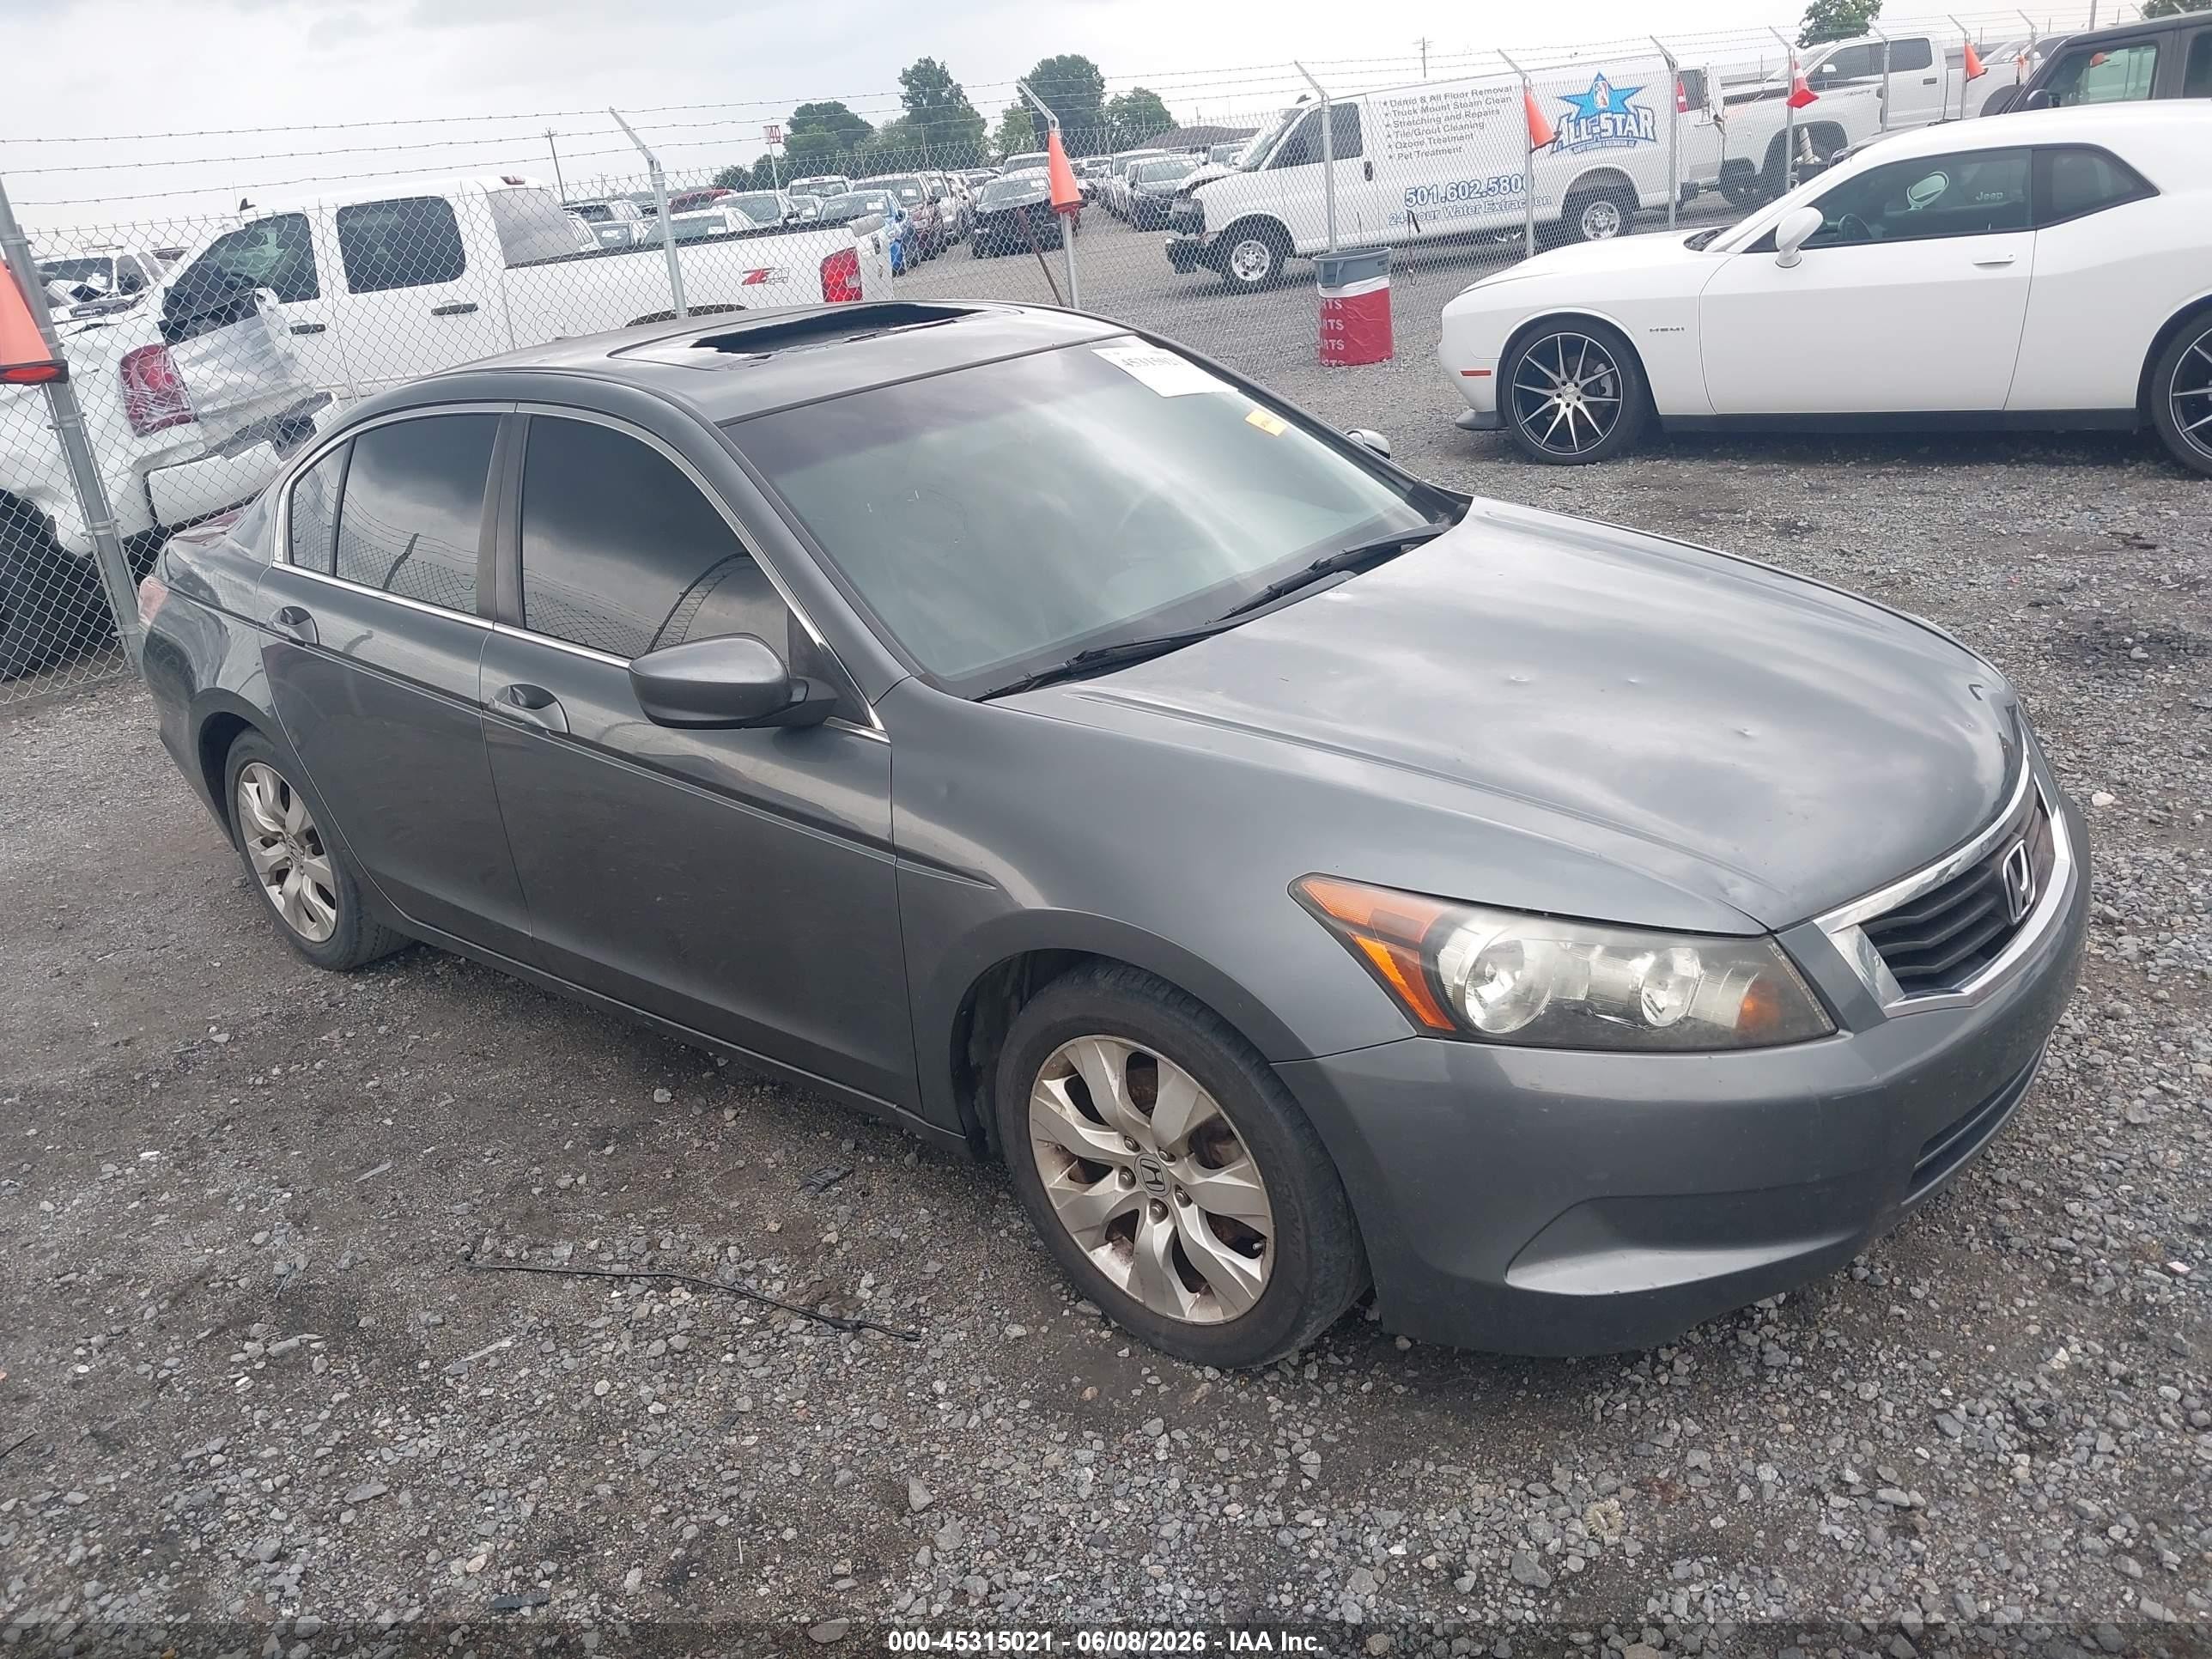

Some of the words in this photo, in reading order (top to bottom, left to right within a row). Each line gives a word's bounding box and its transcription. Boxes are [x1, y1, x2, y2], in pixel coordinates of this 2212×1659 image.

[1429, 93, 1442, 102] All
[1444, 91, 1468, 100] Floor
[1471, 85, 1512, 96] Removal
[1393, 107, 1419, 117] Truck
[1421, 103, 1450, 114] Mount
[1453, 100, 1482, 110] Steam
[1485, 96, 1512, 106] Clean
[1393, 114, 1442, 128] Stretching
[1443, 112, 1462, 122] and
[1464, 108, 1500, 119] Repairs
[1395, 128, 1441, 139] Tile/Grout
[1443, 121, 1485, 133] Cleaning
[1395, 139, 1425, 149] Ozone
[1428, 132, 1474, 145] Treatment
[1397, 149, 1413, 161] Pet
[1416, 146, 1462, 159] Treatment
[1976, 191, 2003, 201] Jeep
[1443, 204, 1480, 218] Water
[1485, 195, 1552, 213] Extracion
